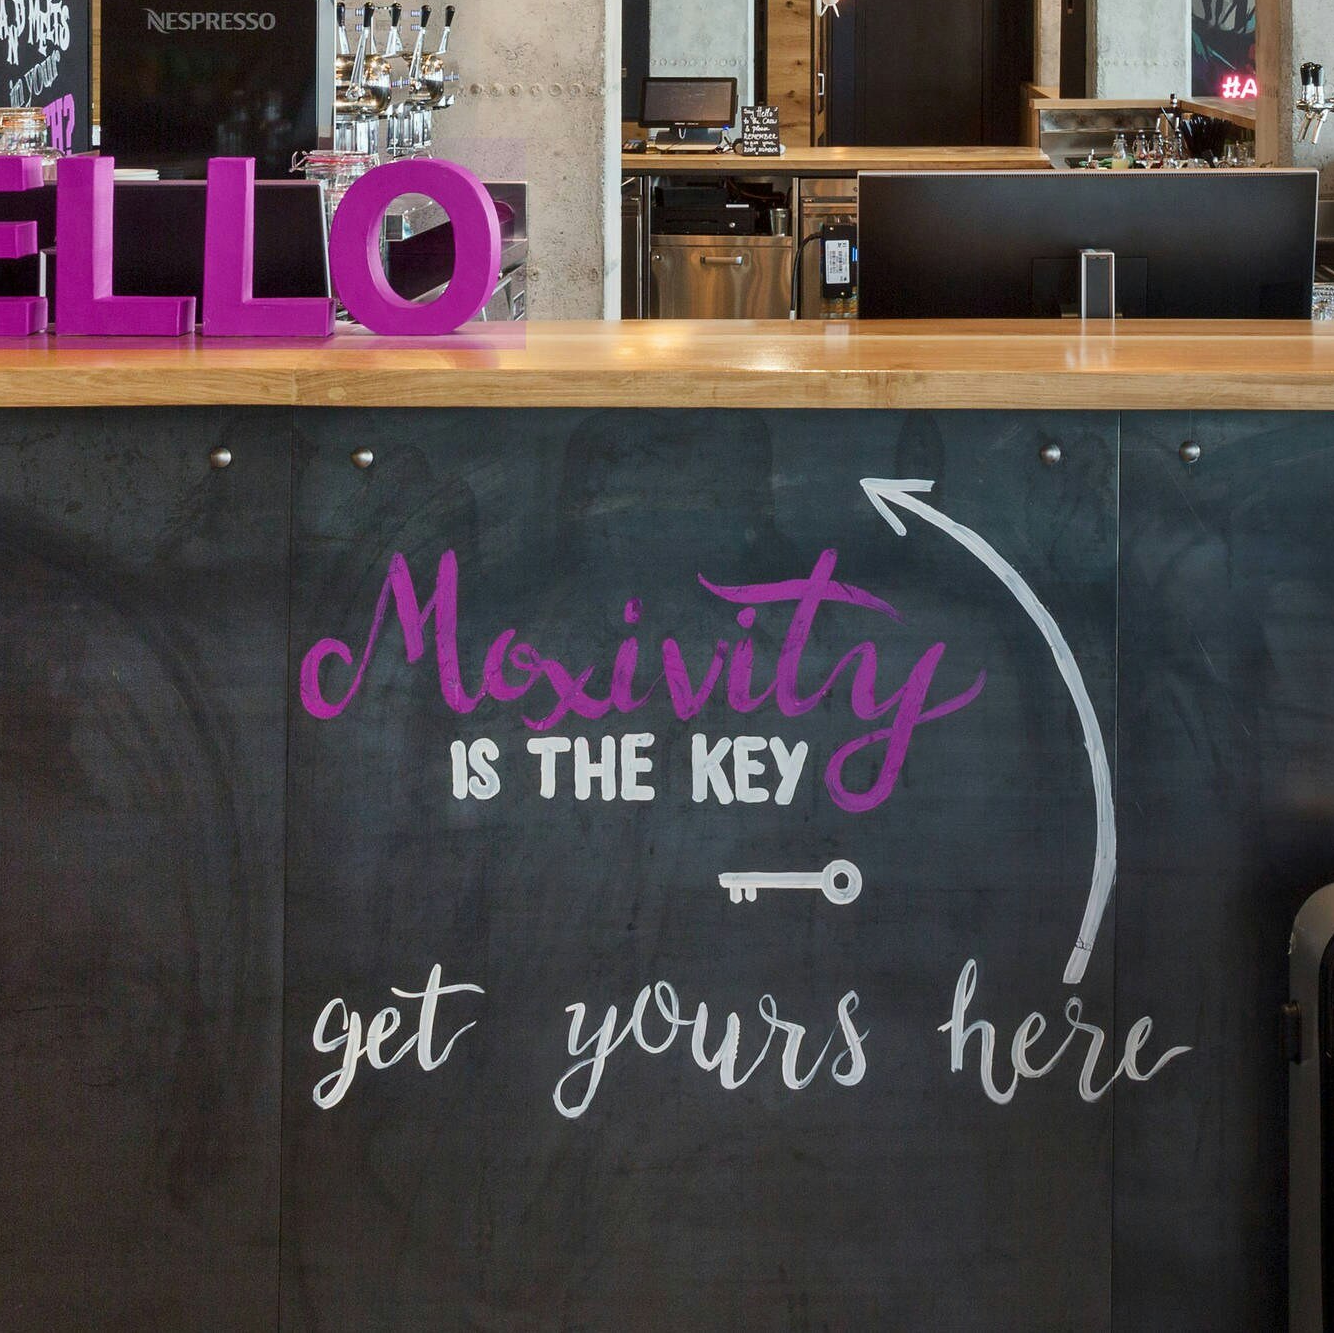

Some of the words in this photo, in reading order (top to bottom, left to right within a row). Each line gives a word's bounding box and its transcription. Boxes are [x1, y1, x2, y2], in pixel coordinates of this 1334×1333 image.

[142, 8, 276, 34] NESPRESSO
[299, 547, 987, 814] Moxivity
[449, 738, 501, 802] IS
[526, 732, 657, 804] THE
[690, 732, 810, 807] KEY
[312, 963, 486, 1110] get
[552, 980, 871, 1119] yours
[937, 958, 1195, 1108] here
